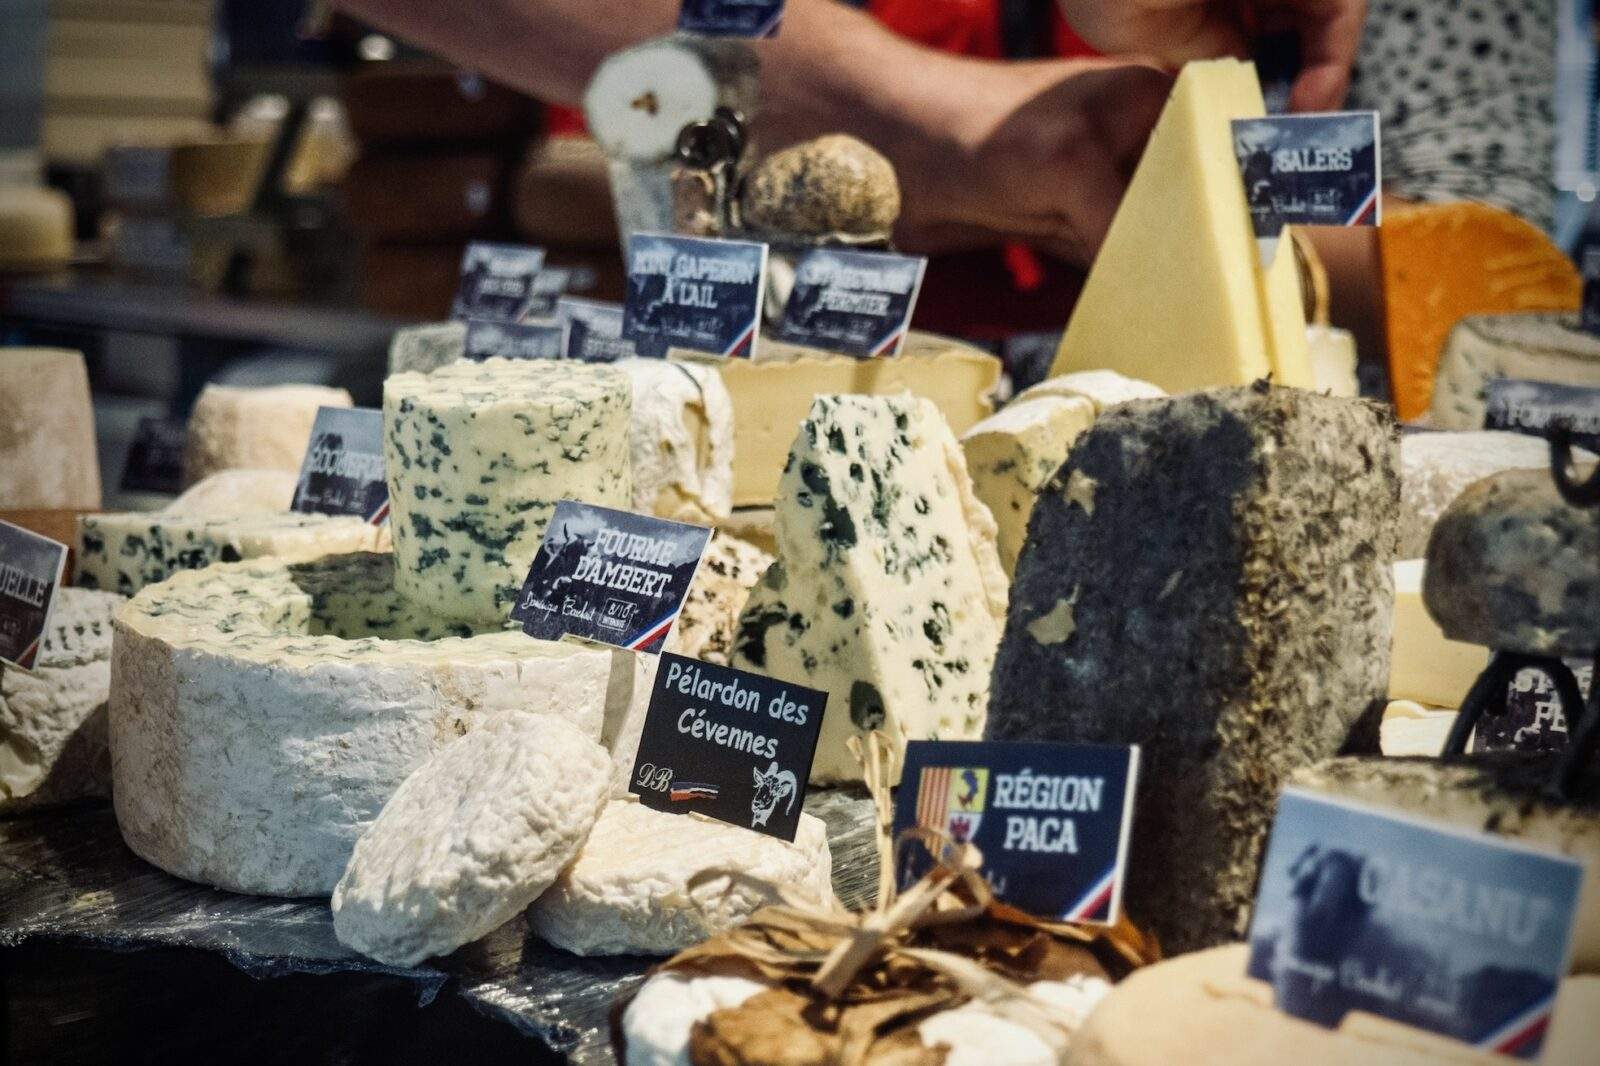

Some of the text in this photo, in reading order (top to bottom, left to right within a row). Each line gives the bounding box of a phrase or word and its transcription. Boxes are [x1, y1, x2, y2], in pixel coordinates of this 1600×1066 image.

[1275, 147, 1353, 172] SALERS
[590, 527, 679, 568] FOURME
[572, 554, 673, 600] D'AMBERT
[664, 662, 809, 726] Pélardon des
[677, 707, 779, 760] Cévennes
[992, 768, 1106, 813] RÉGION
[1003, 816, 1080, 855] PACA
